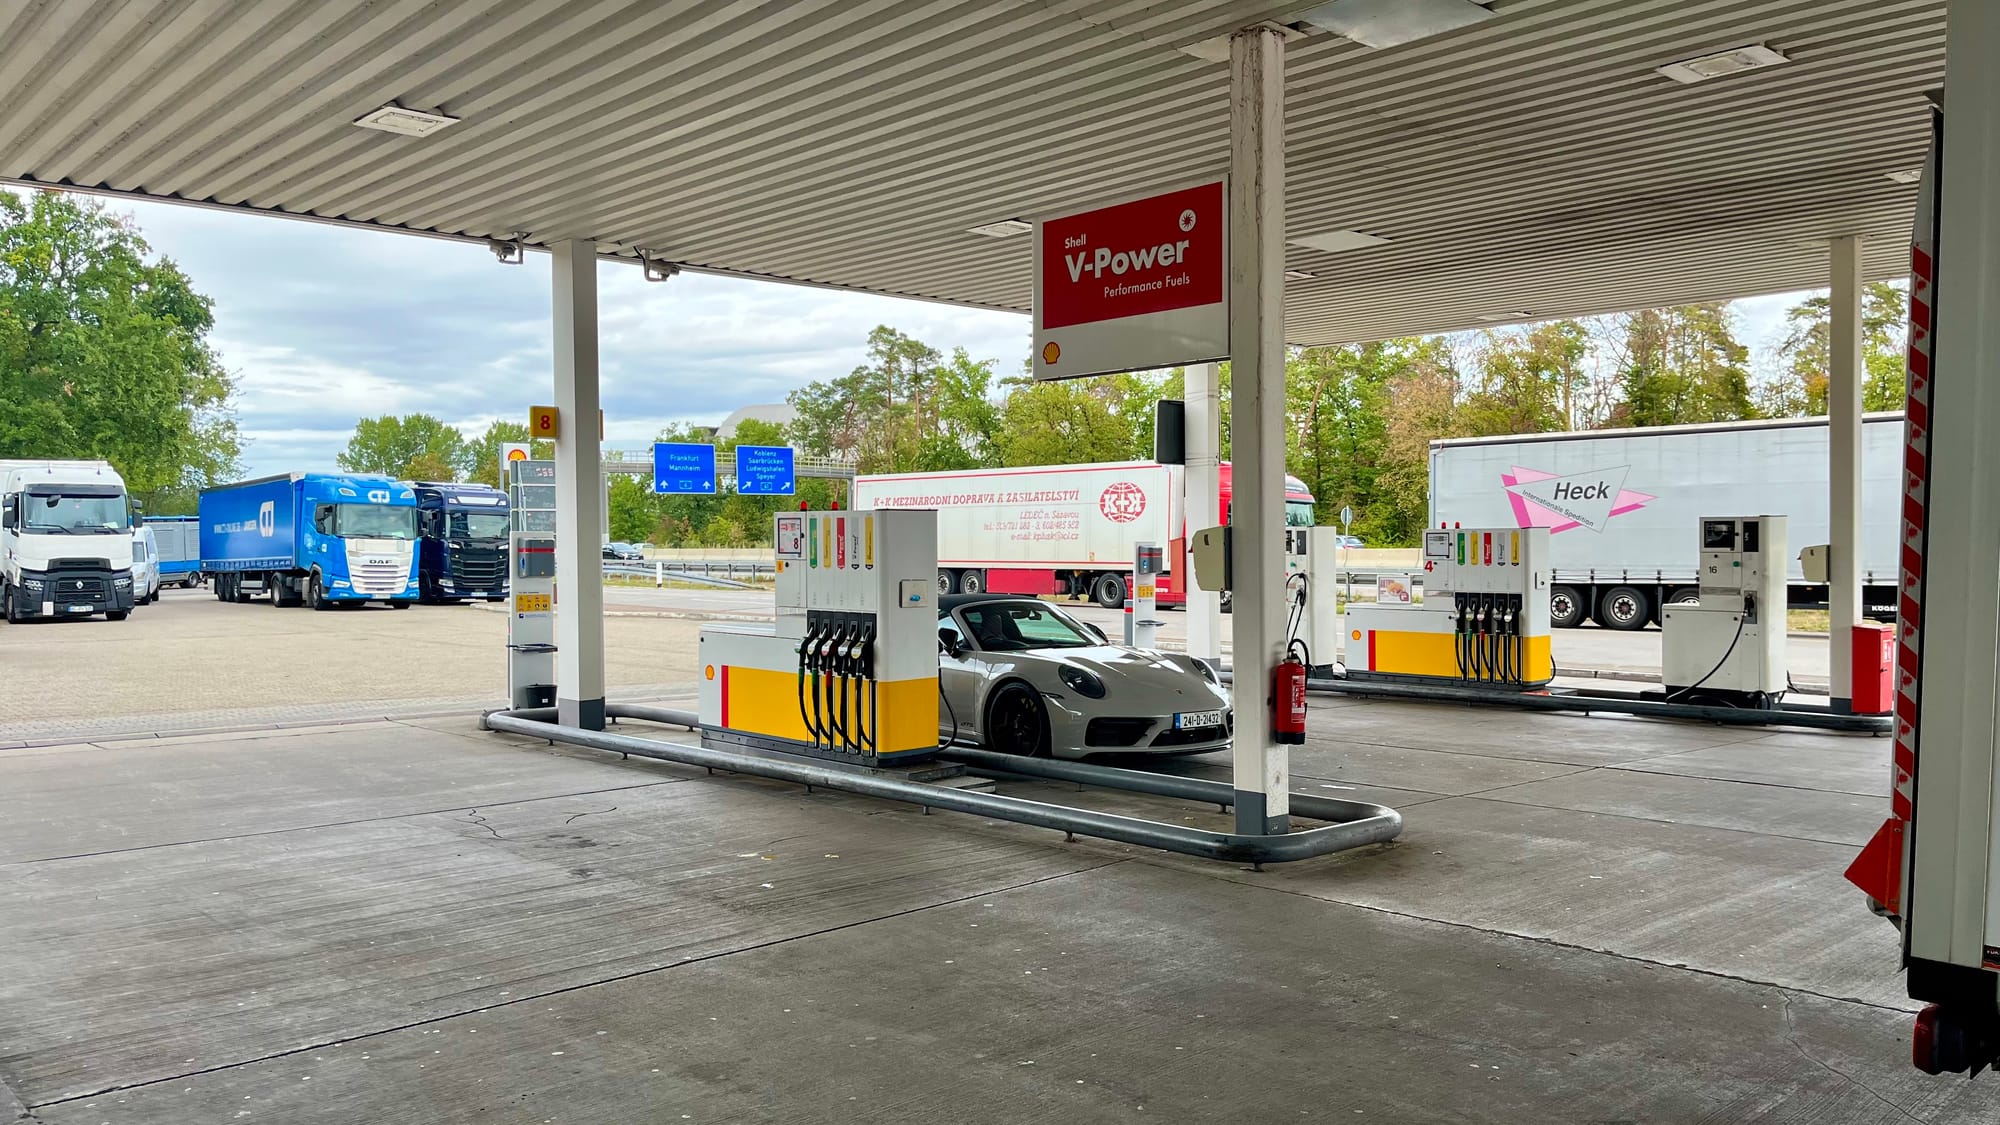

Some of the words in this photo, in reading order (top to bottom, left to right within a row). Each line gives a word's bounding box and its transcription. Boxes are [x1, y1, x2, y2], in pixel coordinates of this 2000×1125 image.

[1064, 233, 1087, 249] Shell
[1064, 240, 1190, 283] V-Power
[1104, 280, 1163, 298] Performance
[1165, 271, 1190, 288] Fuels
[540, 414, 551, 430] 8
[670, 454, 699, 462] Frankfurt
[753, 449, 777, 457] Koblenz
[746, 464, 786, 473] Ludwigshafen
[756, 473, 777, 481] Speyer
[1553, 481, 1611, 501] Heck
[952, 493, 995, 505] DOPRAVA
[997, 493, 1004, 503] A
[1522, 489, 1564, 513] Internationale
[1564, 508, 1594, 527] Spedition
[793, 537, 799, 550] 8
[1424, 560, 1434, 573] 4
[1708, 565, 1718, 575] 16
[1183, 713, 1219, 727] 241-D-21432
